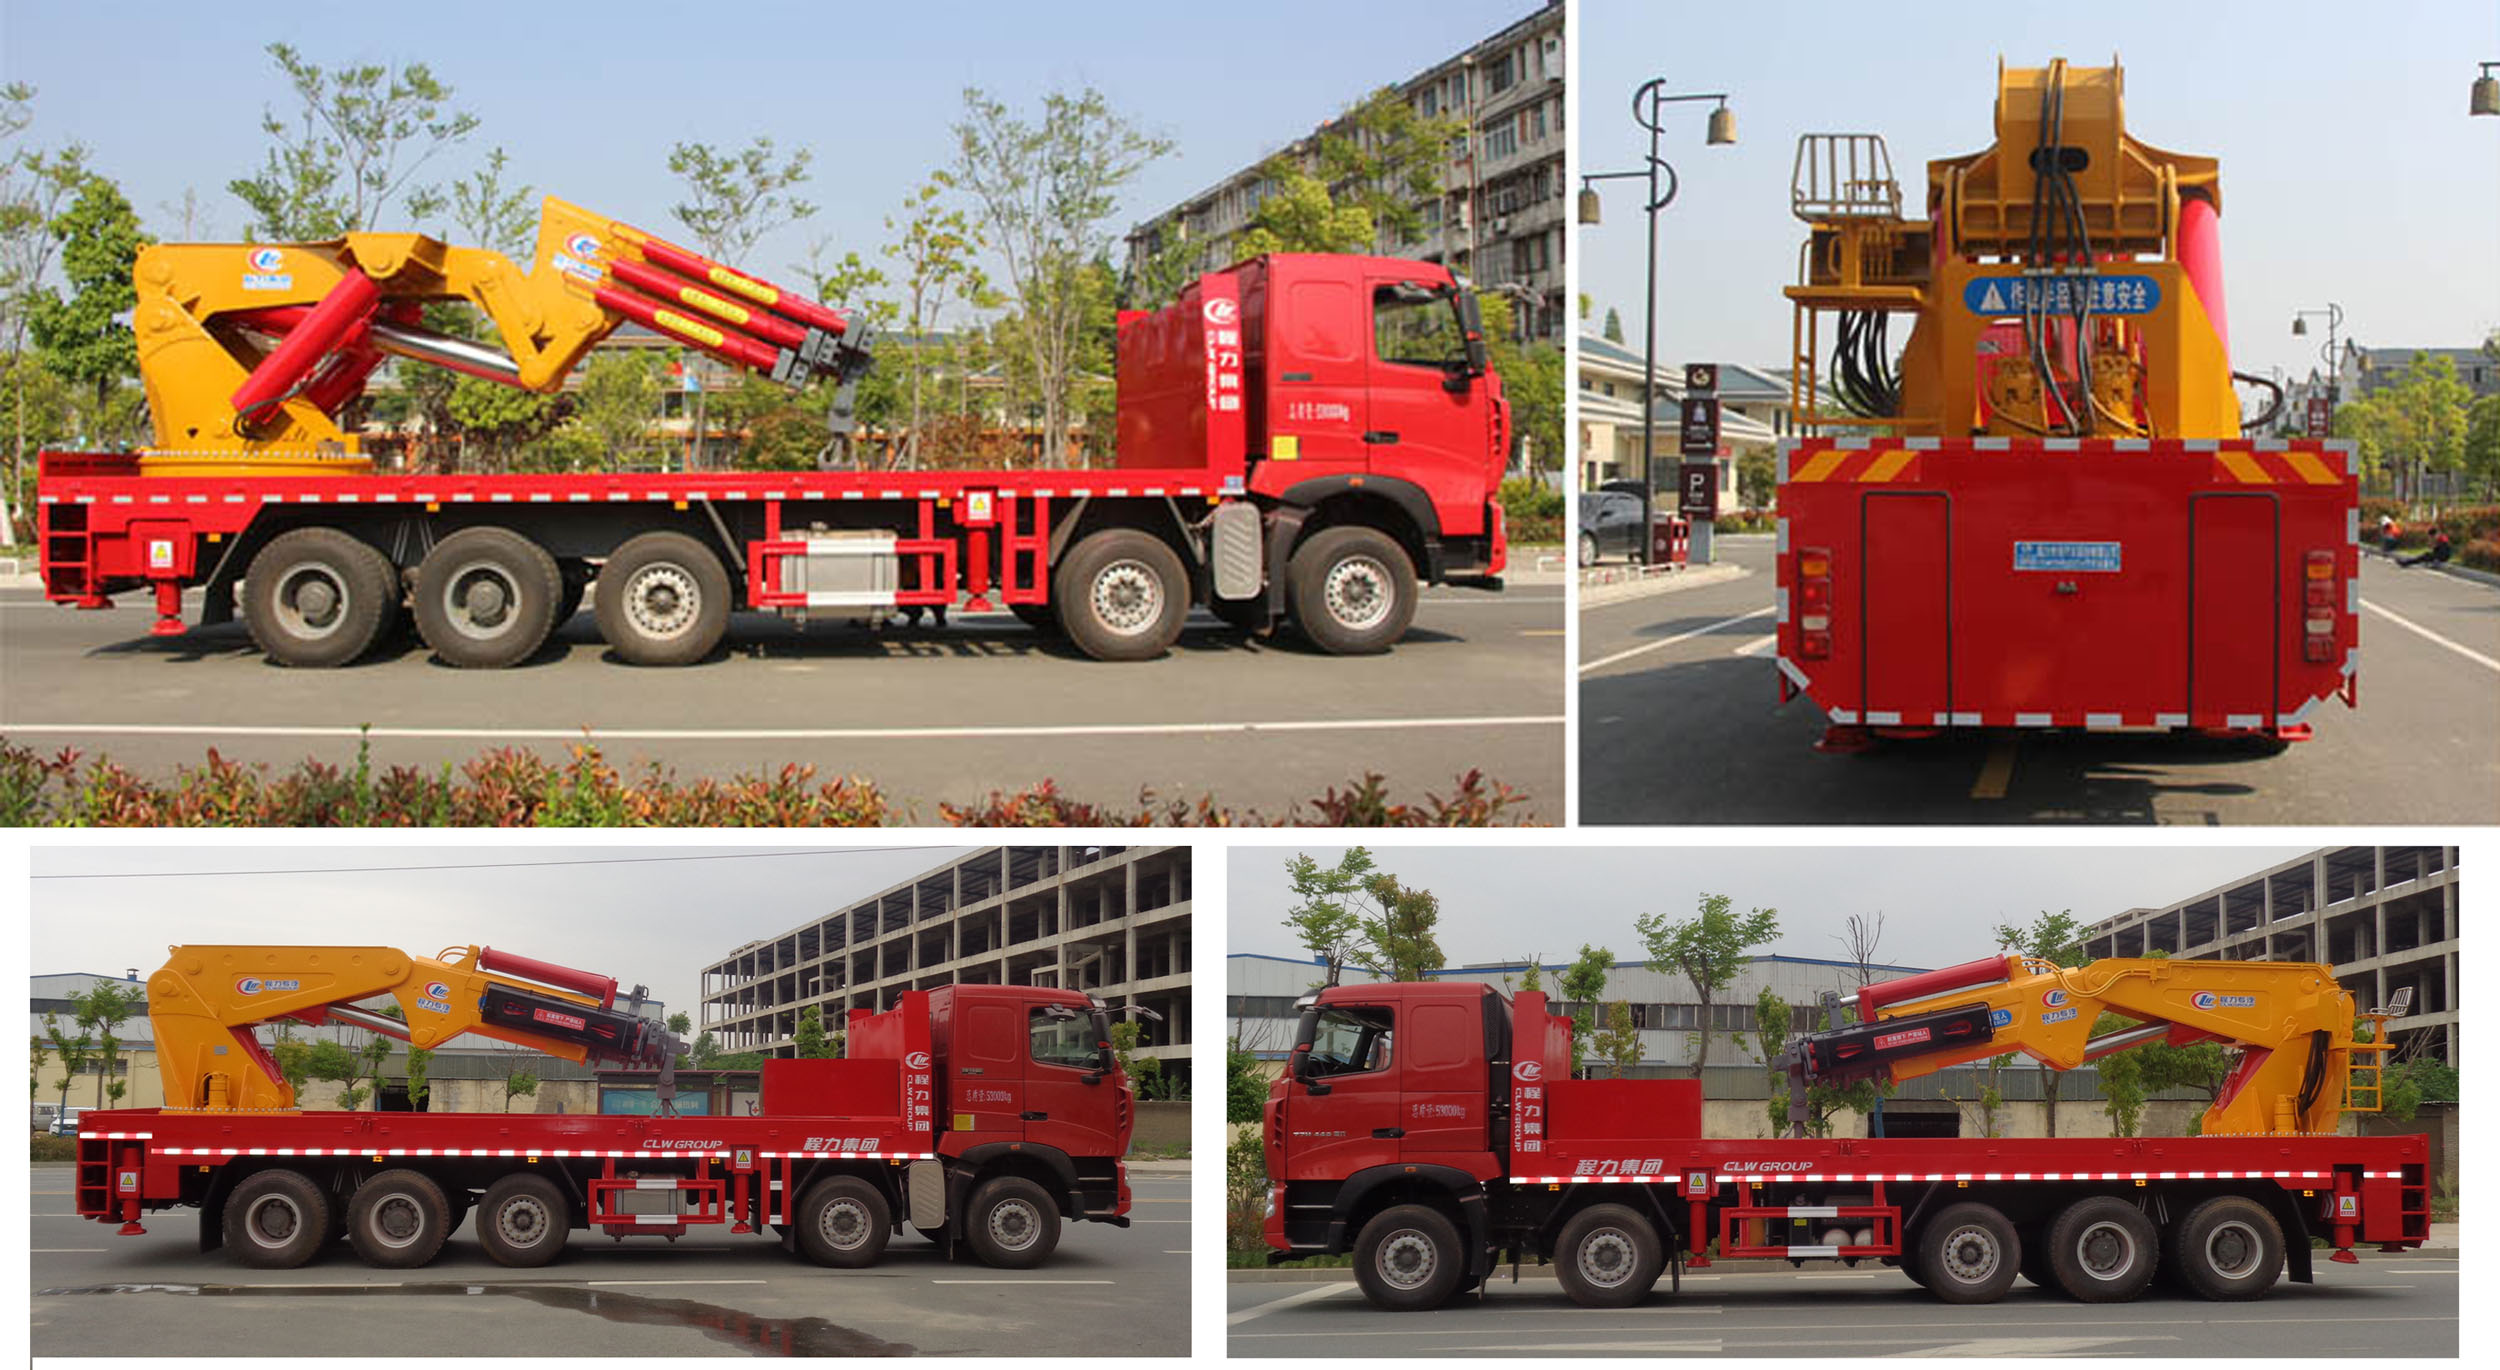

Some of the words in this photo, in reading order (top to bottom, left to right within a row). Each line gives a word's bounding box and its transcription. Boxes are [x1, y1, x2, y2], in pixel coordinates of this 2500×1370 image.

[1690, 473, 1705, 492] P
[915, 1074, 930, 1132] 程力集团
[1514, 1087, 1522, 1112] CLW
[1523, 1087, 1541, 1152] 程力集团
[1514, 1112, 1522, 1153] GROUP
[642, 1139, 673, 1149] CLW
[673, 1139, 723, 1149] GROUP
[803, 1137, 880, 1151] 程力集团
[1575, 1159, 1663, 1175] 程力集团
[1723, 1161, 1758, 1172] CLW
[1758, 1161, 1813, 1172] GROUP
